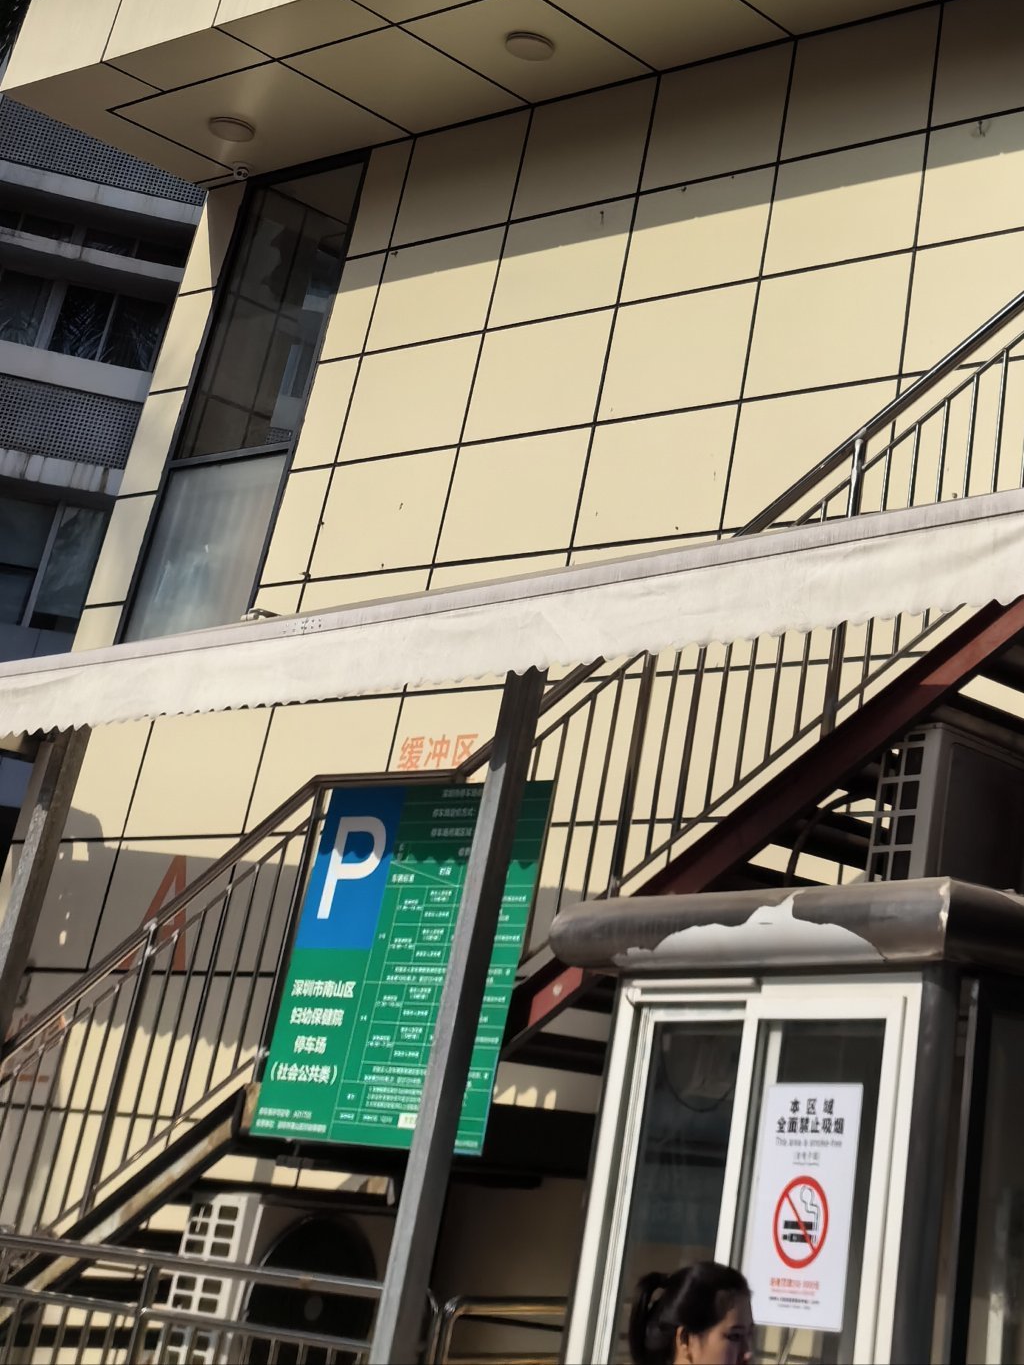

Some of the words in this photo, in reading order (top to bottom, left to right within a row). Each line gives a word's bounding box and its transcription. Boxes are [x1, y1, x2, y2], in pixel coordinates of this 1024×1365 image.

[397, 734, 479, 771] 缓冲区
[316, 816, 386, 919] P
[291, 979, 356, 999] 深圳市南山区
[289, 1007, 344, 1027] 妇幼保健院
[293, 1035, 327, 1055] 停车场
[776, 1116, 844, 1135] 全面禁止吸烟
